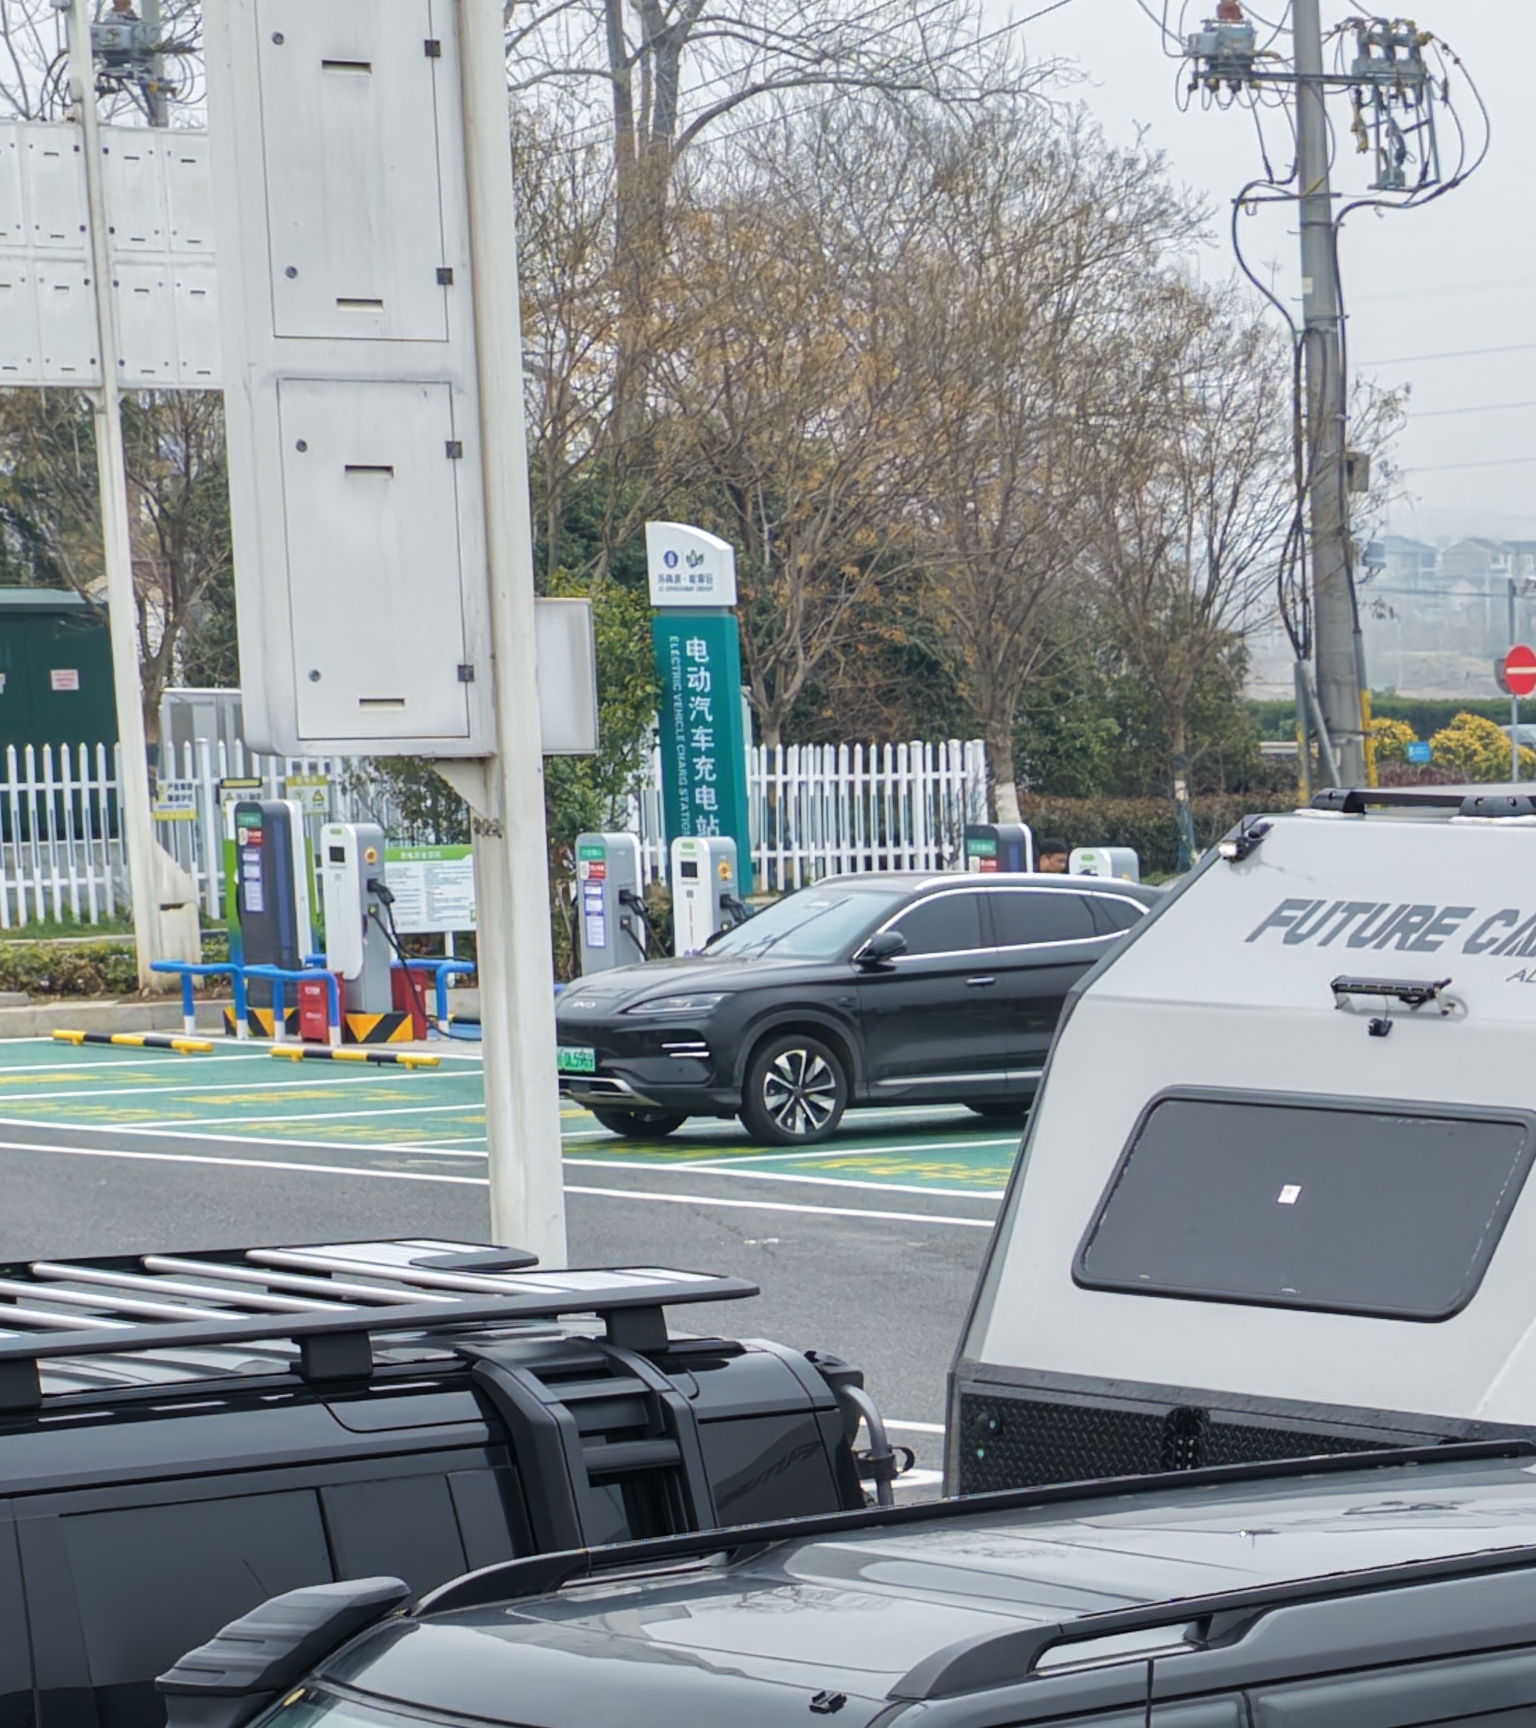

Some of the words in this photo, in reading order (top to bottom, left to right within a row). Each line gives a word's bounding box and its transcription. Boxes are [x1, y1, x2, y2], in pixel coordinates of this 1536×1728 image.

[669, 636, 682, 691] ELECTRIC
[674, 694, 686, 741] VEHICLE
[685, 636, 719, 837] 电动汽车充电站
[1245, 897, 1477, 954] FUTURE
